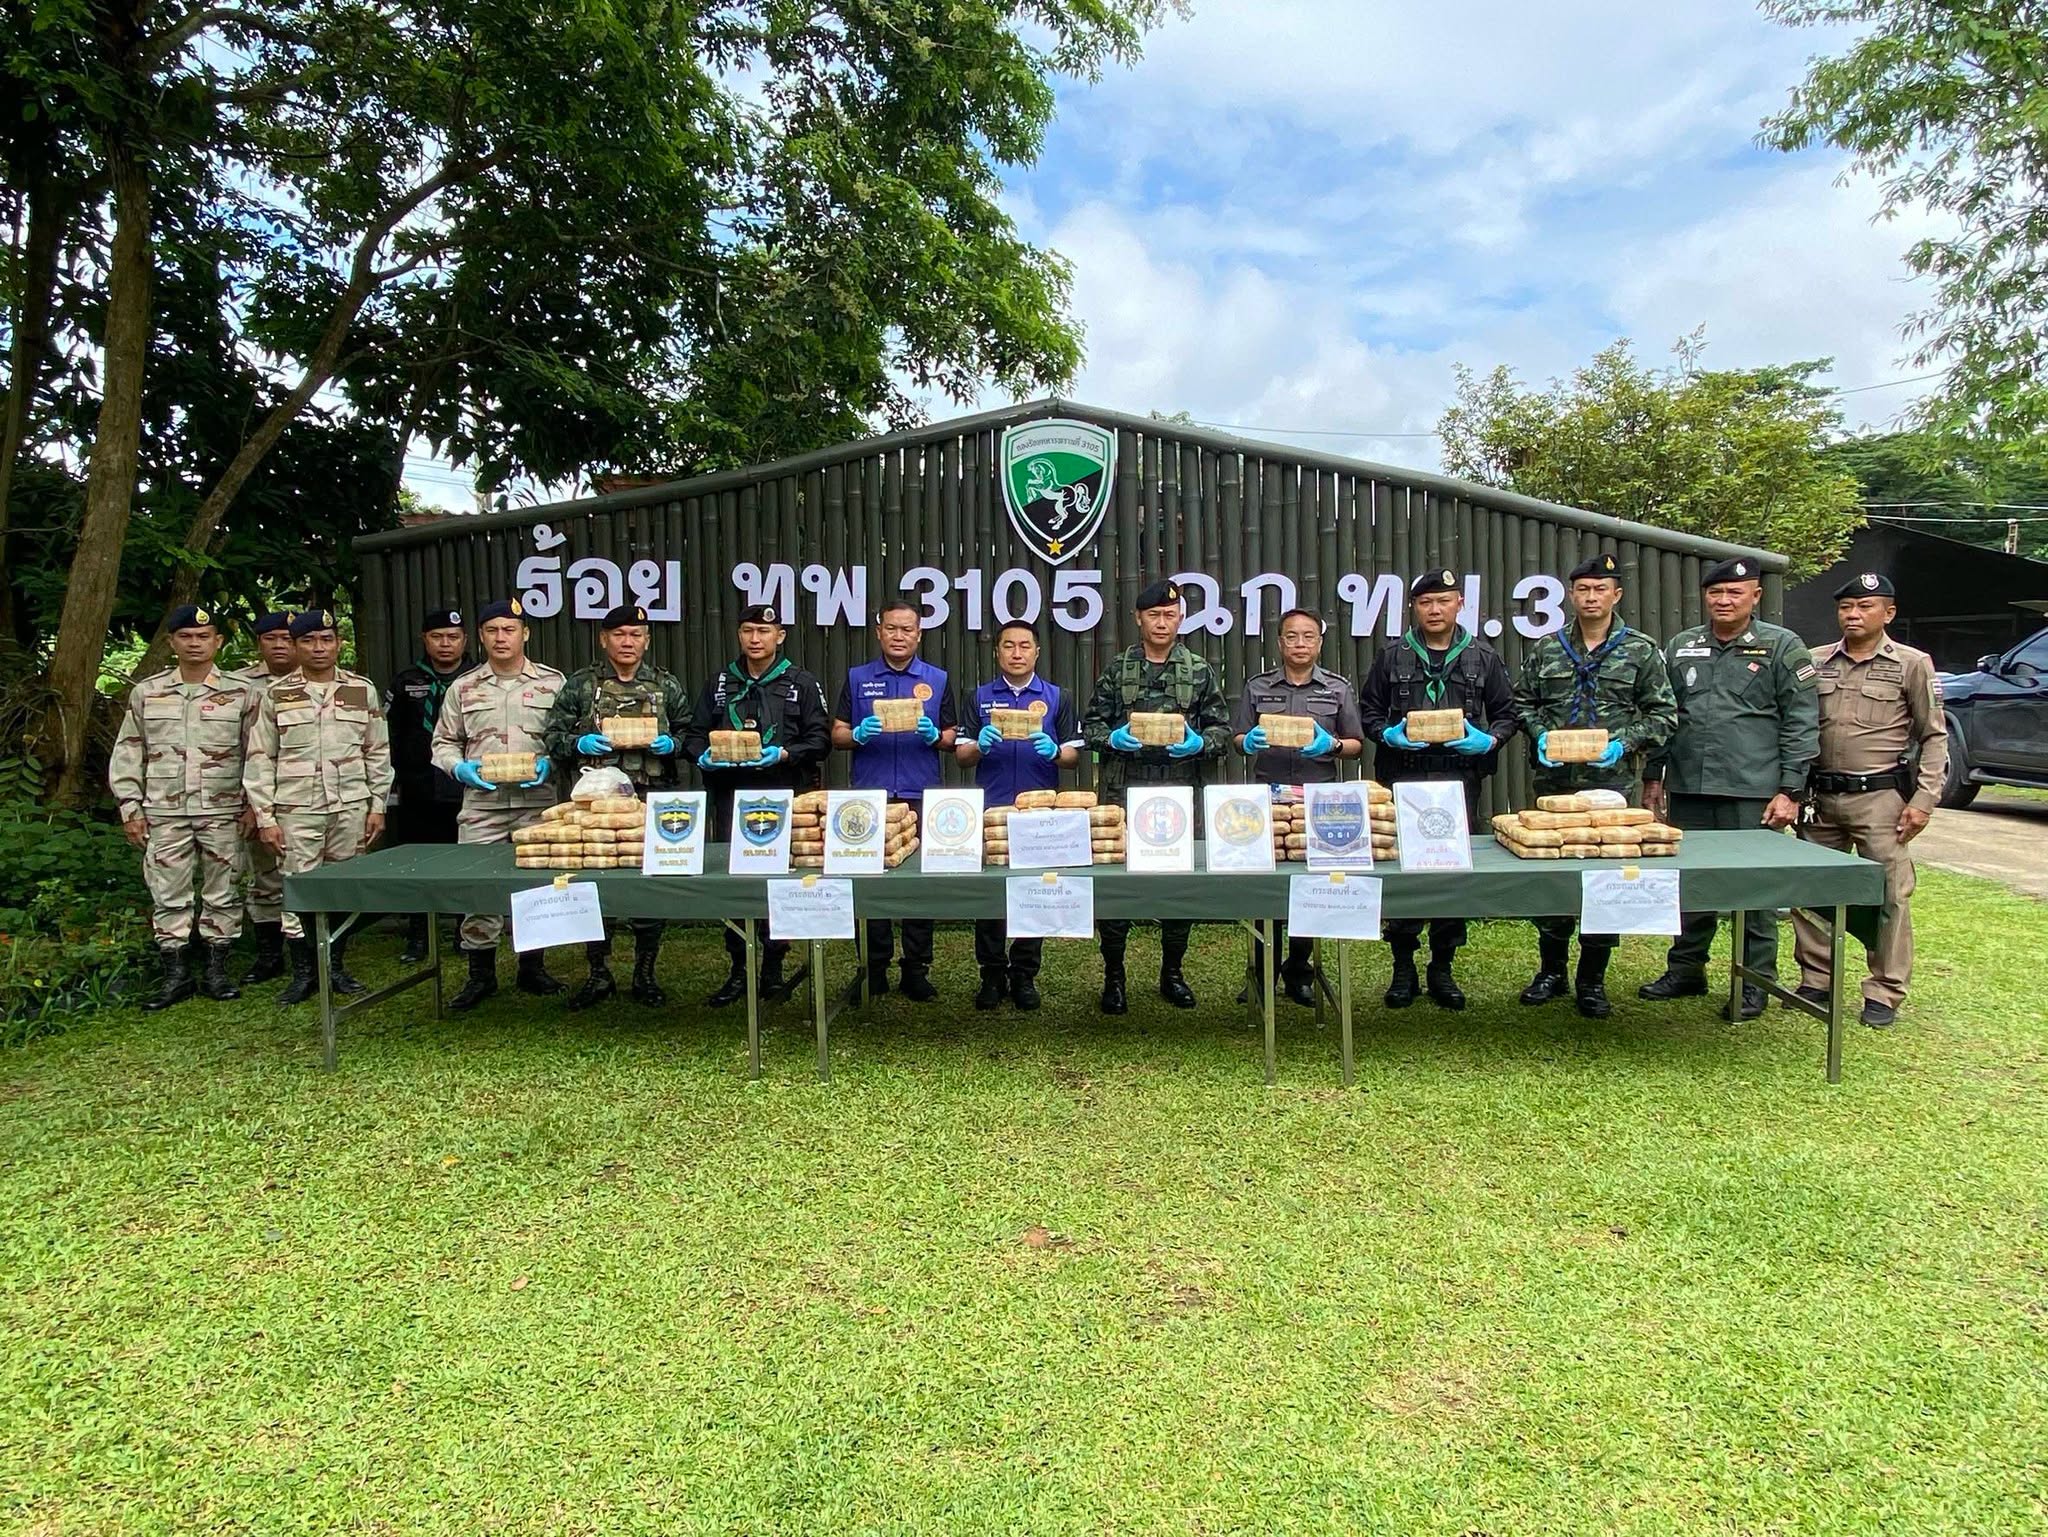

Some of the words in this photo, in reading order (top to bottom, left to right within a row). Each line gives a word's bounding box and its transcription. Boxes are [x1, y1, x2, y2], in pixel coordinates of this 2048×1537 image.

[1081, 440, 1100, 453] 3105
[516, 522, 682, 623] ร้อย
[731, 561, 1104, 633] ทพ3105
[1167, 571, 1566, 639] ฉกท.3
